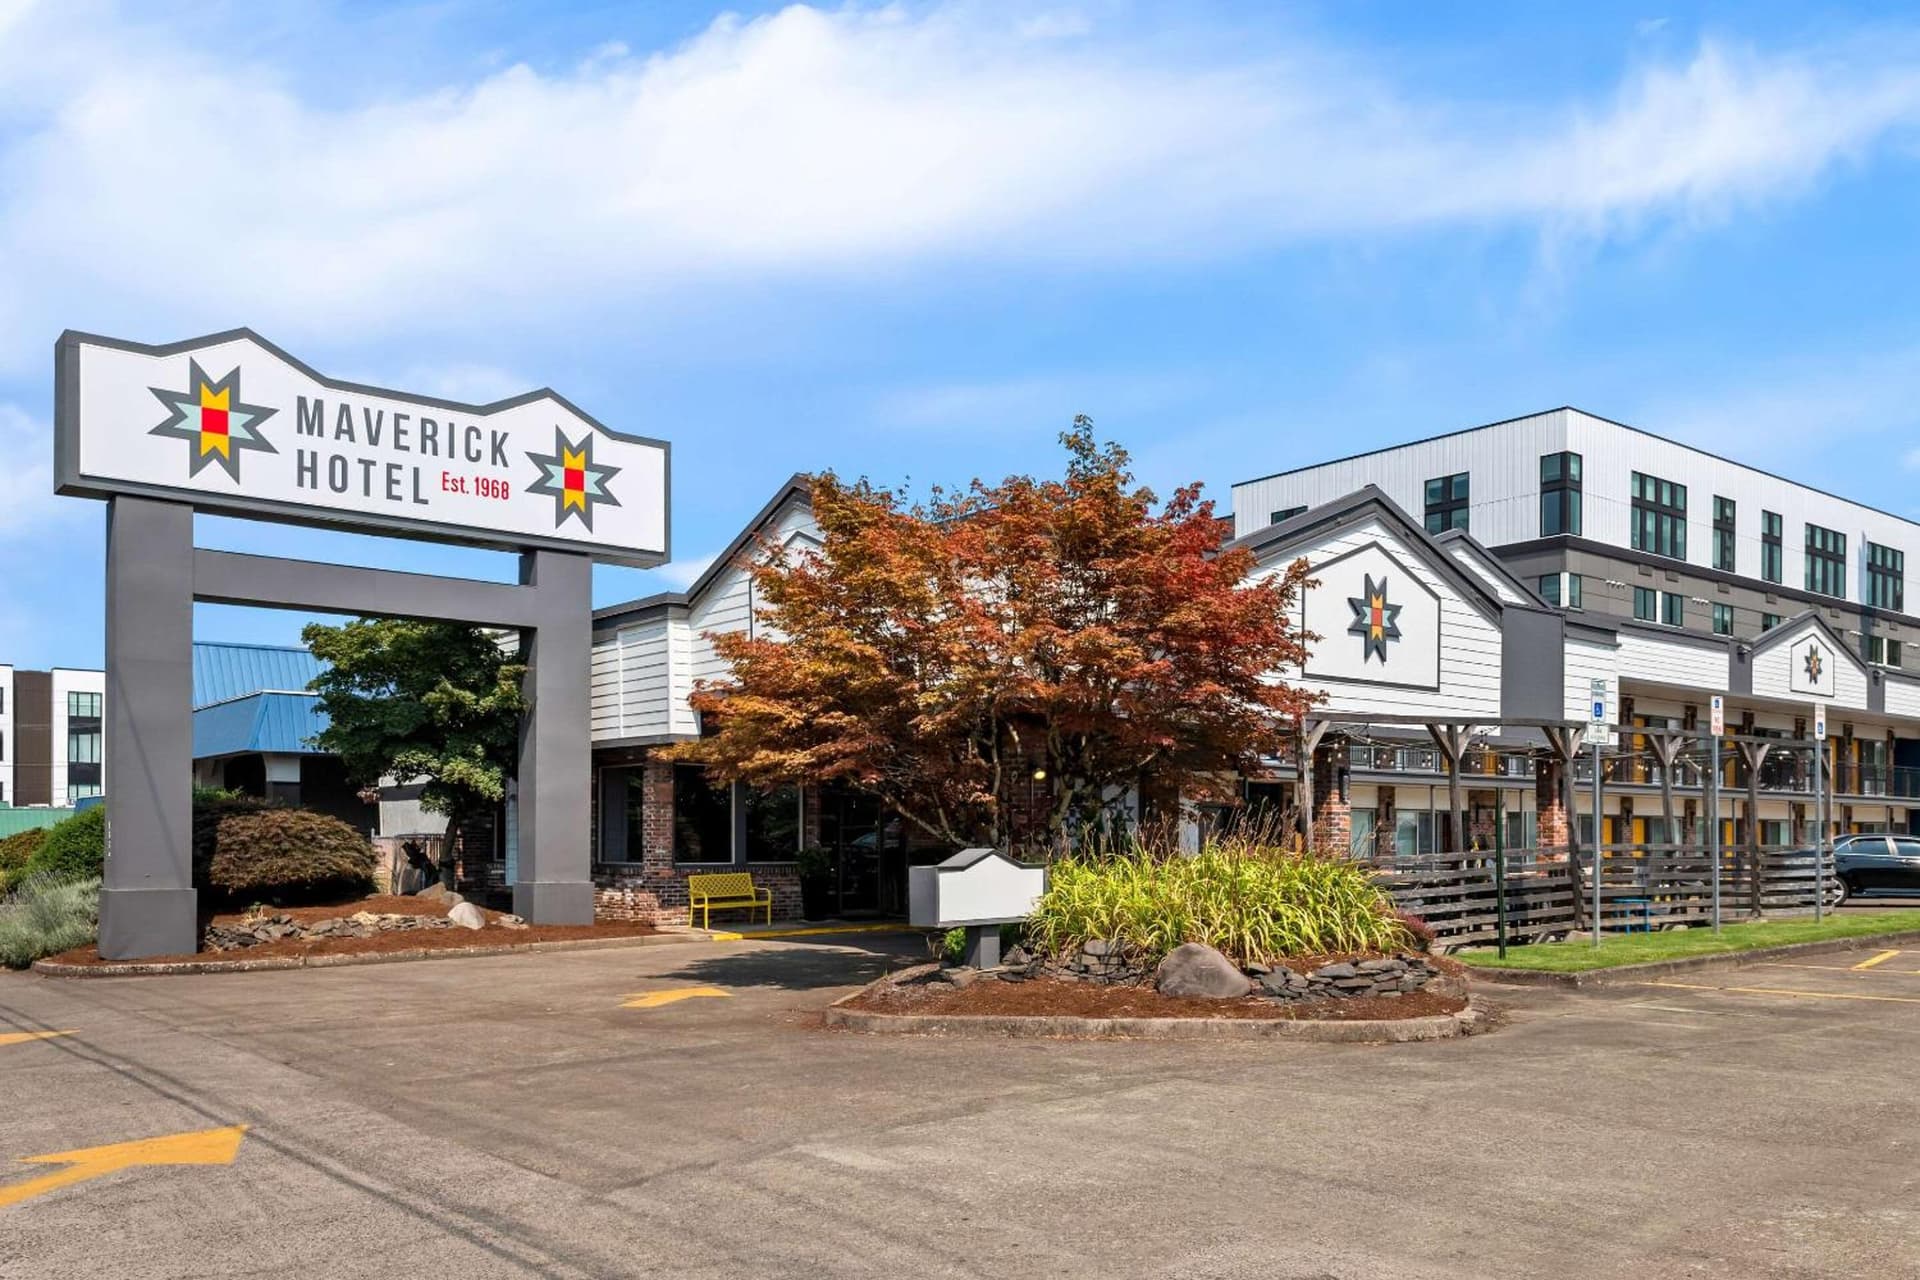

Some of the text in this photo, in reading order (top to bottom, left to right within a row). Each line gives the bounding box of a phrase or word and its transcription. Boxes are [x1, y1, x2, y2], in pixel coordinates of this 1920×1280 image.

[296, 395, 510, 468] MAVERICK
[296, 448, 430, 505] HOTEL
[441, 471, 510, 500] Est. 1968
